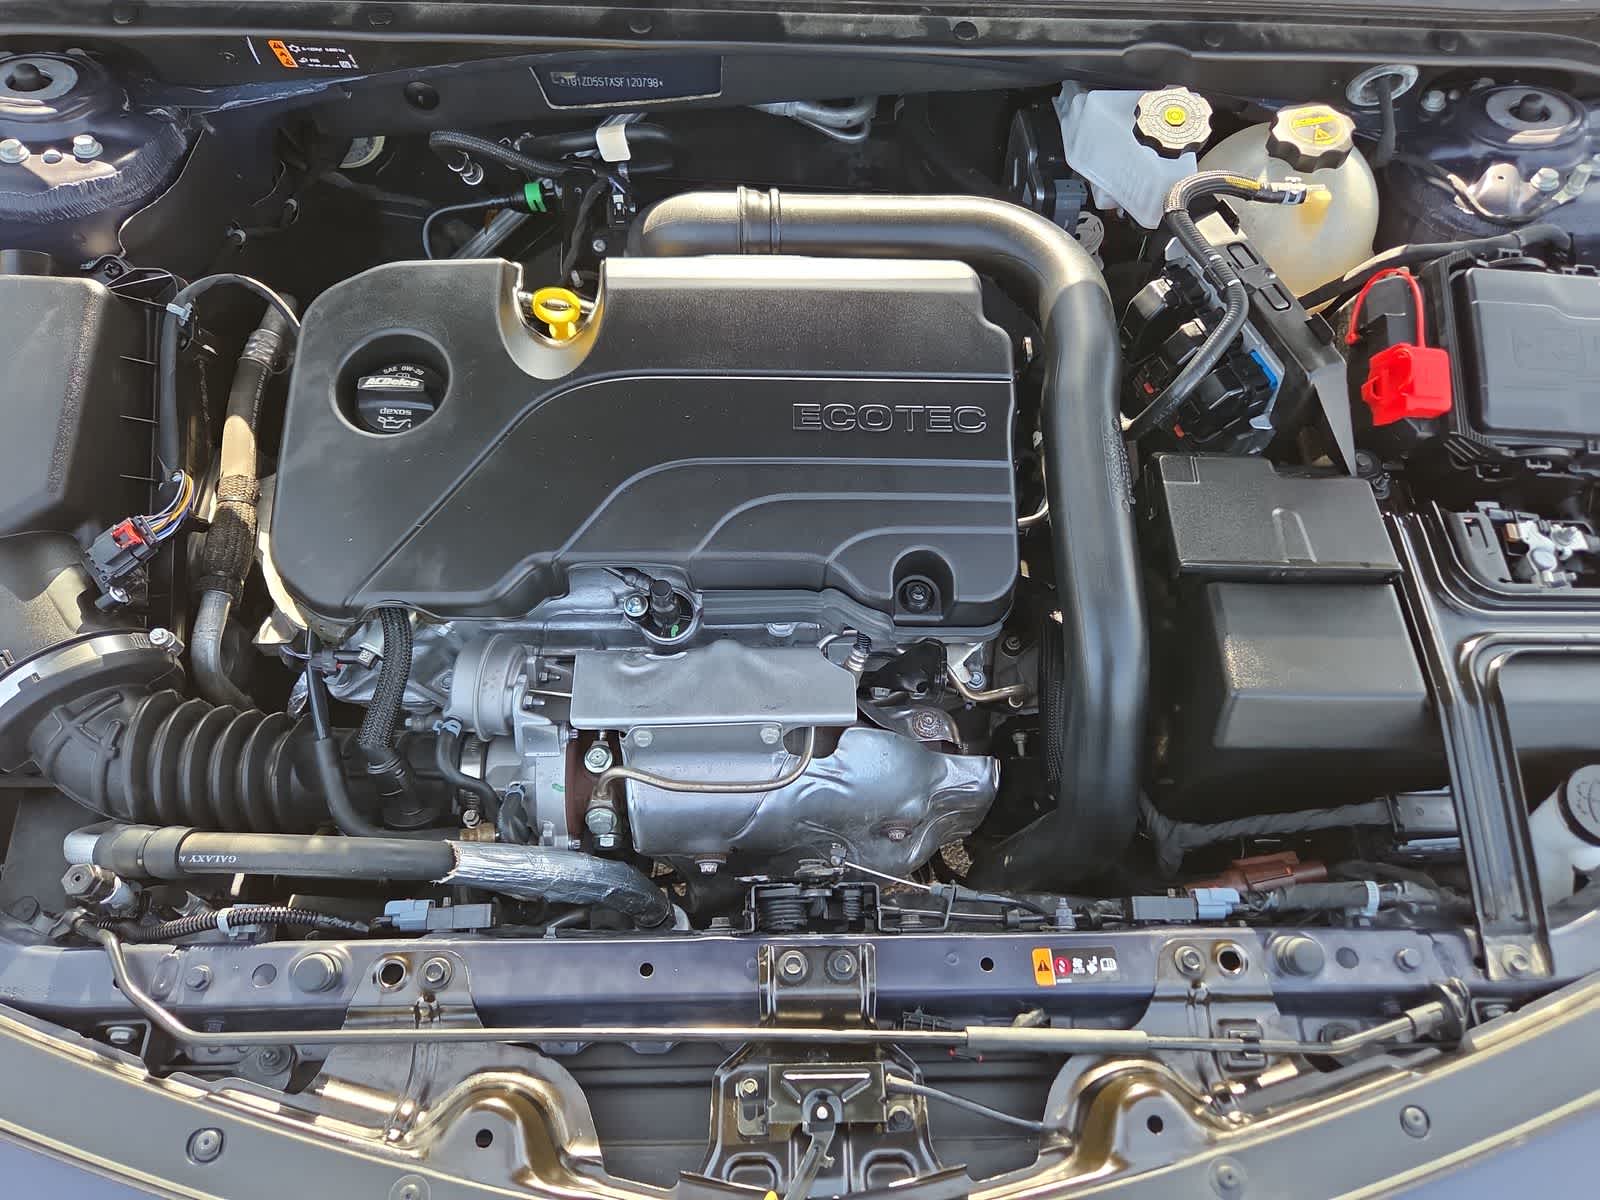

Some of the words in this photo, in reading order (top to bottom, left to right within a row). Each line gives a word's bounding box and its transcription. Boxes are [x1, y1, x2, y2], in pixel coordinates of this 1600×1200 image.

[383, 366, 398, 374] SAE
[365, 377, 420, 387] ACDelco
[379, 407, 412, 416] dexos
[792, 403, 987, 433] ECOTEC
[190, 854, 237, 863] GALAXY
